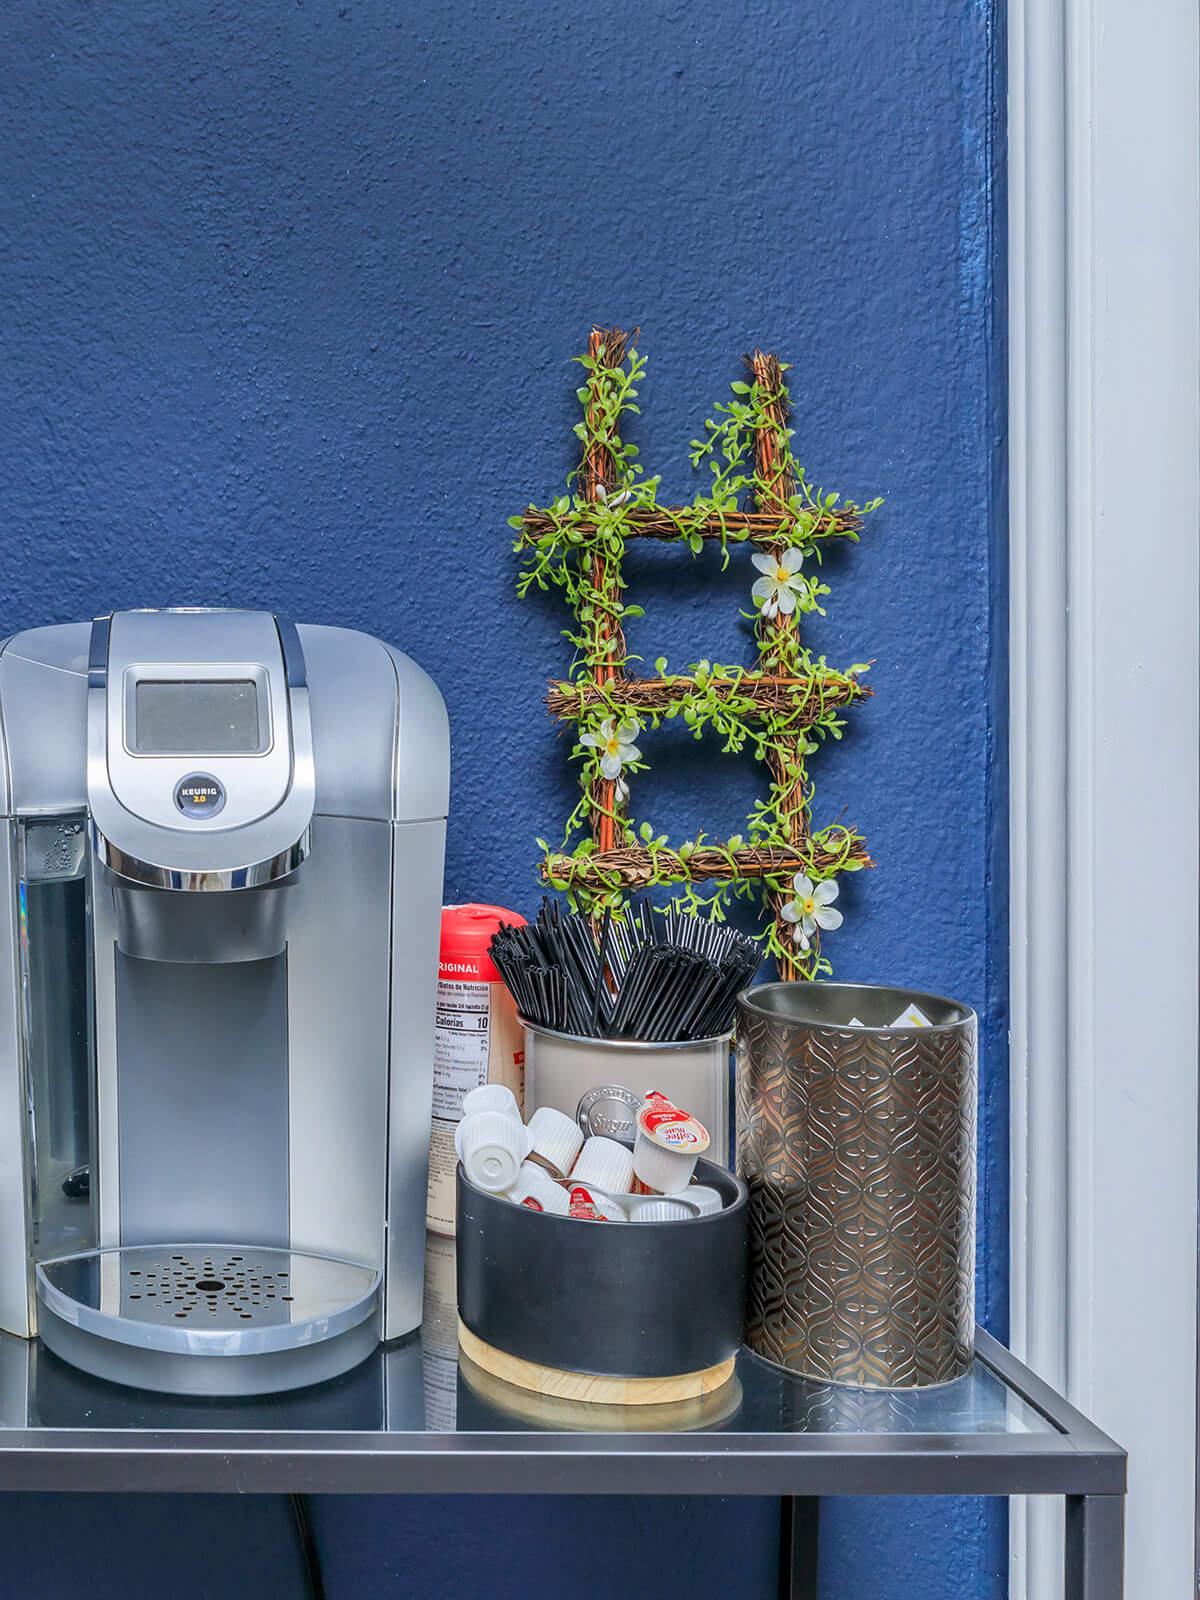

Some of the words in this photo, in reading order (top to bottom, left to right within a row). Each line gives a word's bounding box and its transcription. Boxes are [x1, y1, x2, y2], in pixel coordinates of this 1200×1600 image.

[182, 788, 217, 796] KEURIG
[477, 1017, 488, 1029] 10
[593, 1112, 633, 1134] Sugar
